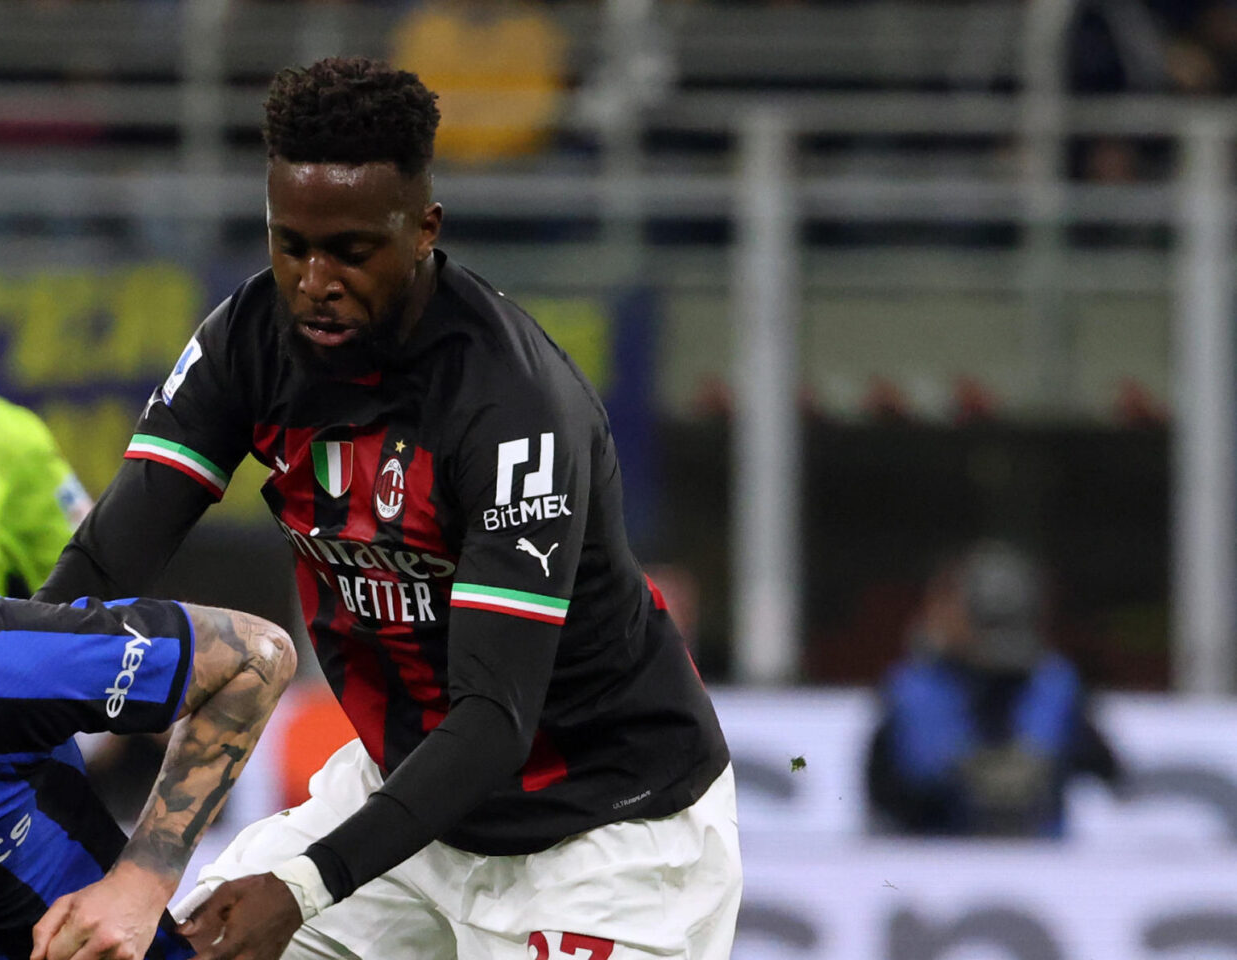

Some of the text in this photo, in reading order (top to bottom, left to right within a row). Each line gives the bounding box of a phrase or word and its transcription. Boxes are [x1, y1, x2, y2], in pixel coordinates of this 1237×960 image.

[483, 494, 572, 531] BitMEX
[276, 515, 456, 580] mirates
[337, 574, 436, 622] BETTER
[105, 621, 152, 718] ebay
